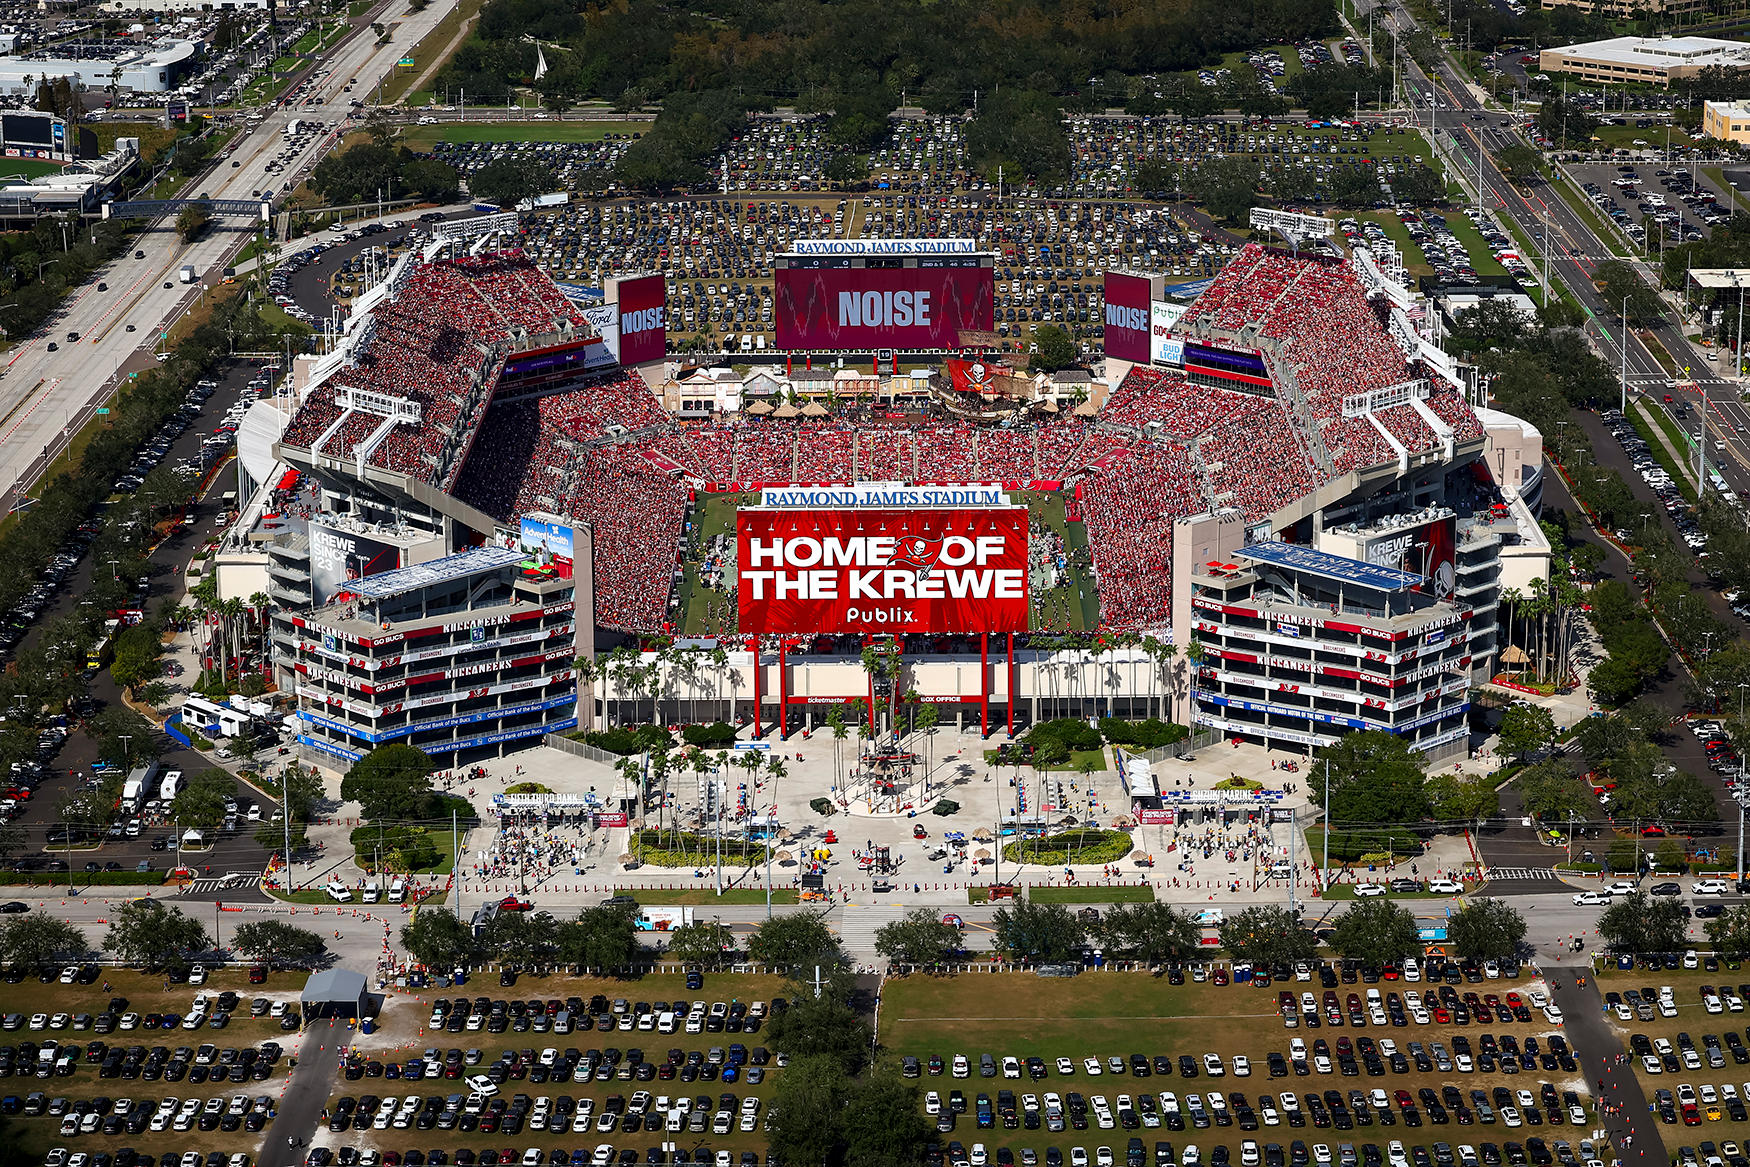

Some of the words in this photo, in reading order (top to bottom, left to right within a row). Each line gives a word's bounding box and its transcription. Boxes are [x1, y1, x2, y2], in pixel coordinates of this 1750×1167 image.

[796, 243, 865, 253] RAYMOND
[868, 243, 912, 253] JAMES
[914, 242, 973, 253] STADIUM
[586, 308, 612, 324] Ford
[838, 290, 930, 327] NOISE
[1154, 306, 1182, 319] Publi
[622, 306, 664, 335] NOISE
[1106, 304, 1148, 331] NOISE
[1154, 325, 1162, 336] GO
[1160, 351, 1183, 362] LIGHT
[1163, 344, 1180, 354] BUD
[766, 492, 857, 506] RAYMOND
[860, 492, 918, 505] JAMES
[923, 491, 1000, 505] STADIUM
[313, 530, 355, 553] KREWE
[524, 527, 569, 545] AdventHealth
[750, 537, 896, 567] HOME
[938, 536, 1005, 566] OF
[1369, 534, 1413, 558] KREWE
[741, 570, 838, 600] THE
[849, 570, 1024, 599] KREWE
[555, 604, 572, 613] BUCS
[1205, 602, 1223, 612] BUCS
[443, 615, 511, 633] BUCCANEERS
[1257, 610, 1324, 628] BUCCANEERS
[1408, 613, 1462, 637] BUCCANEERS
[304, 620, 359, 644] BUCCANEERS
[1373, 630, 1391, 639] BUCS
[374, 637, 385, 646] GO
[386, 634, 404, 644] BUCS
[556, 649, 574, 658] BUCS
[1204, 647, 1221, 657] BUCS
[445, 660, 512, 679] BUCCANEERS
[1257, 655, 1324, 674] BUCCANEERS
[1406, 659, 1461, 684] BUCCANEERS
[307, 666, 361, 690] BUCCANEERS
[388, 680, 406, 690] BUCS
[1371, 676, 1390, 686] BUCS
[312, 717, 326, 725] Official
[487, 710, 504, 719] Official
[414, 722, 432, 731] Official
[488, 734, 504, 743] Official
[314, 741, 326, 749] Official
[349, 752, 359, 760] Bucs
[1193, 790, 1221, 800] SUZUKI
[1222, 790, 1252, 800] MARINE
